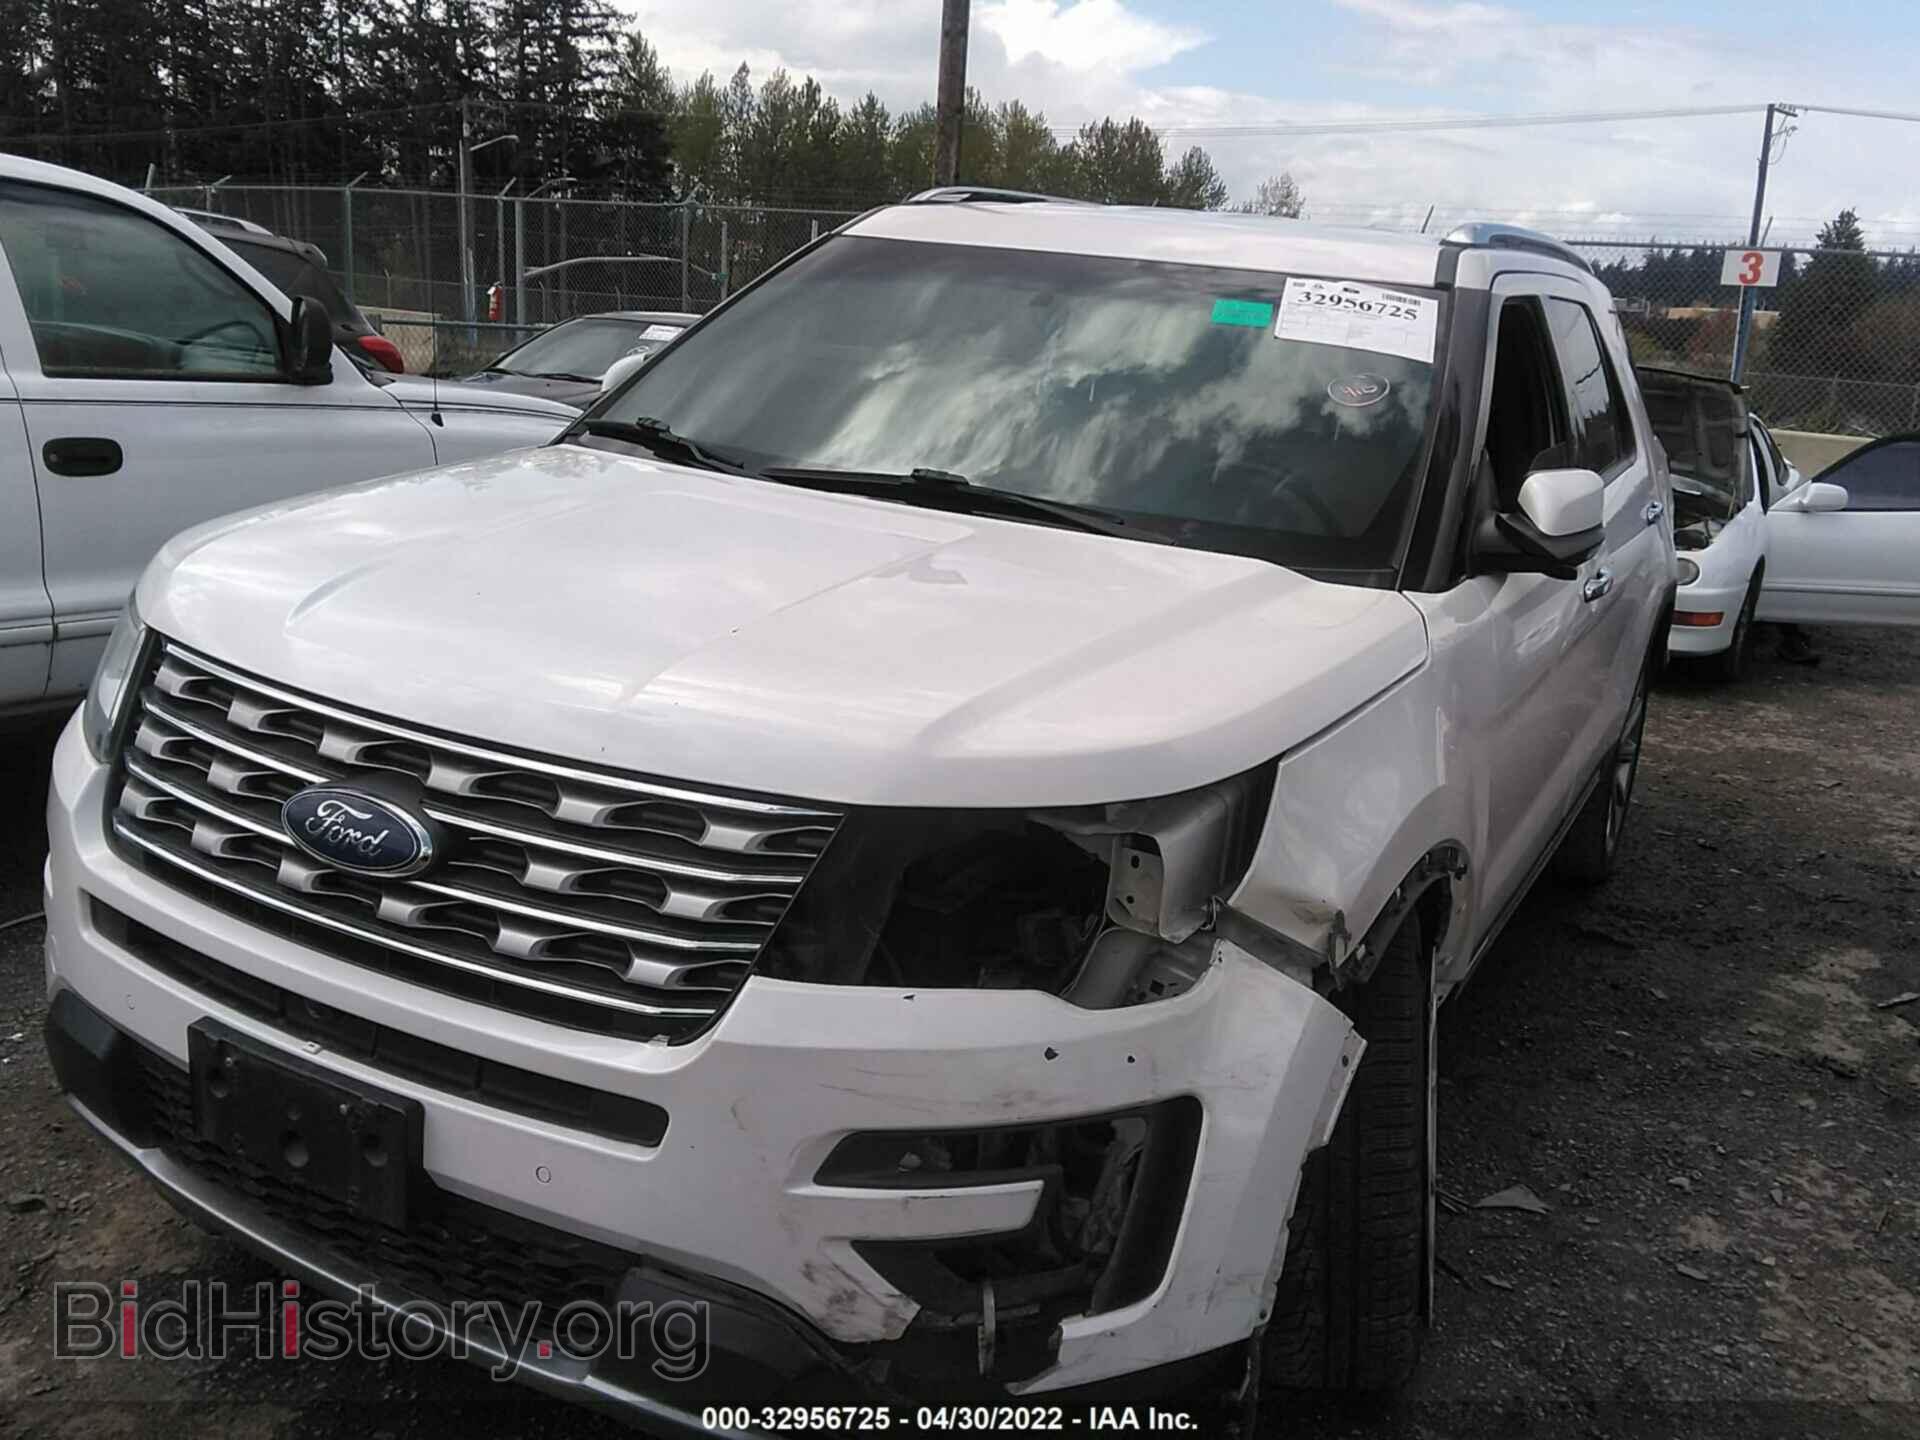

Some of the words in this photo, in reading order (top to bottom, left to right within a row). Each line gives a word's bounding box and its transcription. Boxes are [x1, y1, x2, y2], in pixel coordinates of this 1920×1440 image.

[1738, 252, 1764, 285] 3
[1297, 291, 1418, 321] 32956725
[305, 800, 390, 856] Ford
